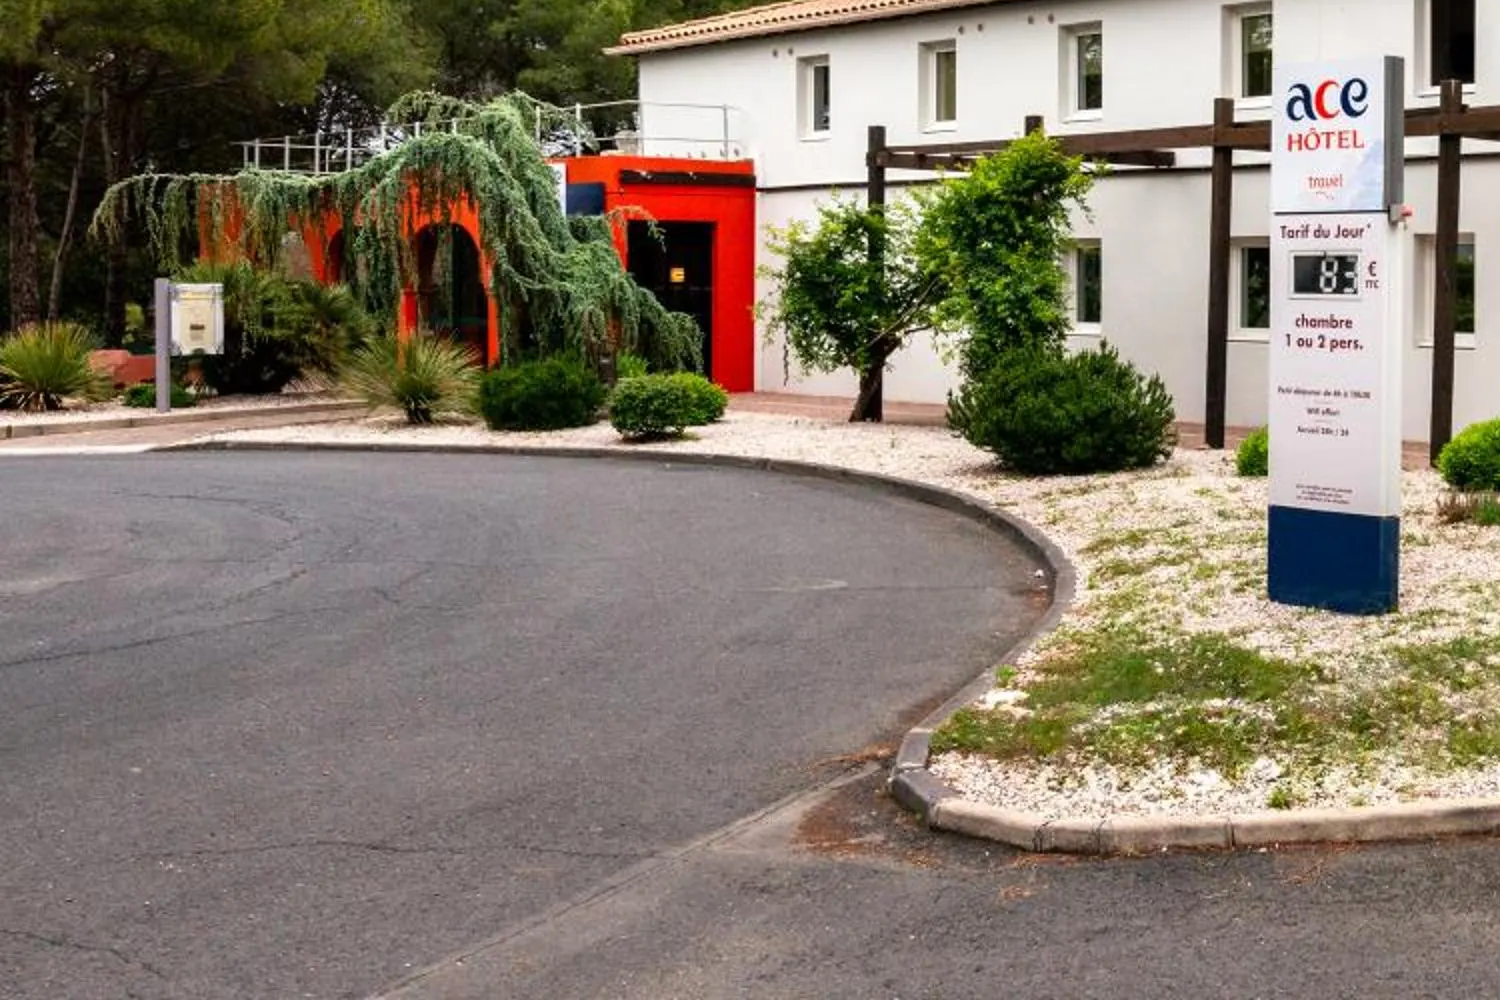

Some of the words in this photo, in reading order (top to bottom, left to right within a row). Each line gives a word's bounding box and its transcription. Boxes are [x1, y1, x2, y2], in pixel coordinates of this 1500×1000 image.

[1286, 77, 1369, 121] ace
[1287, 128, 1365, 152] HÔTEL
[1308, 174, 1343, 189] travel
[1280, 224, 1309, 239] Tarif
[1313, 224, 1331, 238] du
[1295, 314, 1353, 329] chambre
[1285, 333, 1291, 347] 1
[1296, 337, 1313, 348] ou
[1317, 334, 1326, 349] 2
[1330, 338, 1364, 352] pers.
